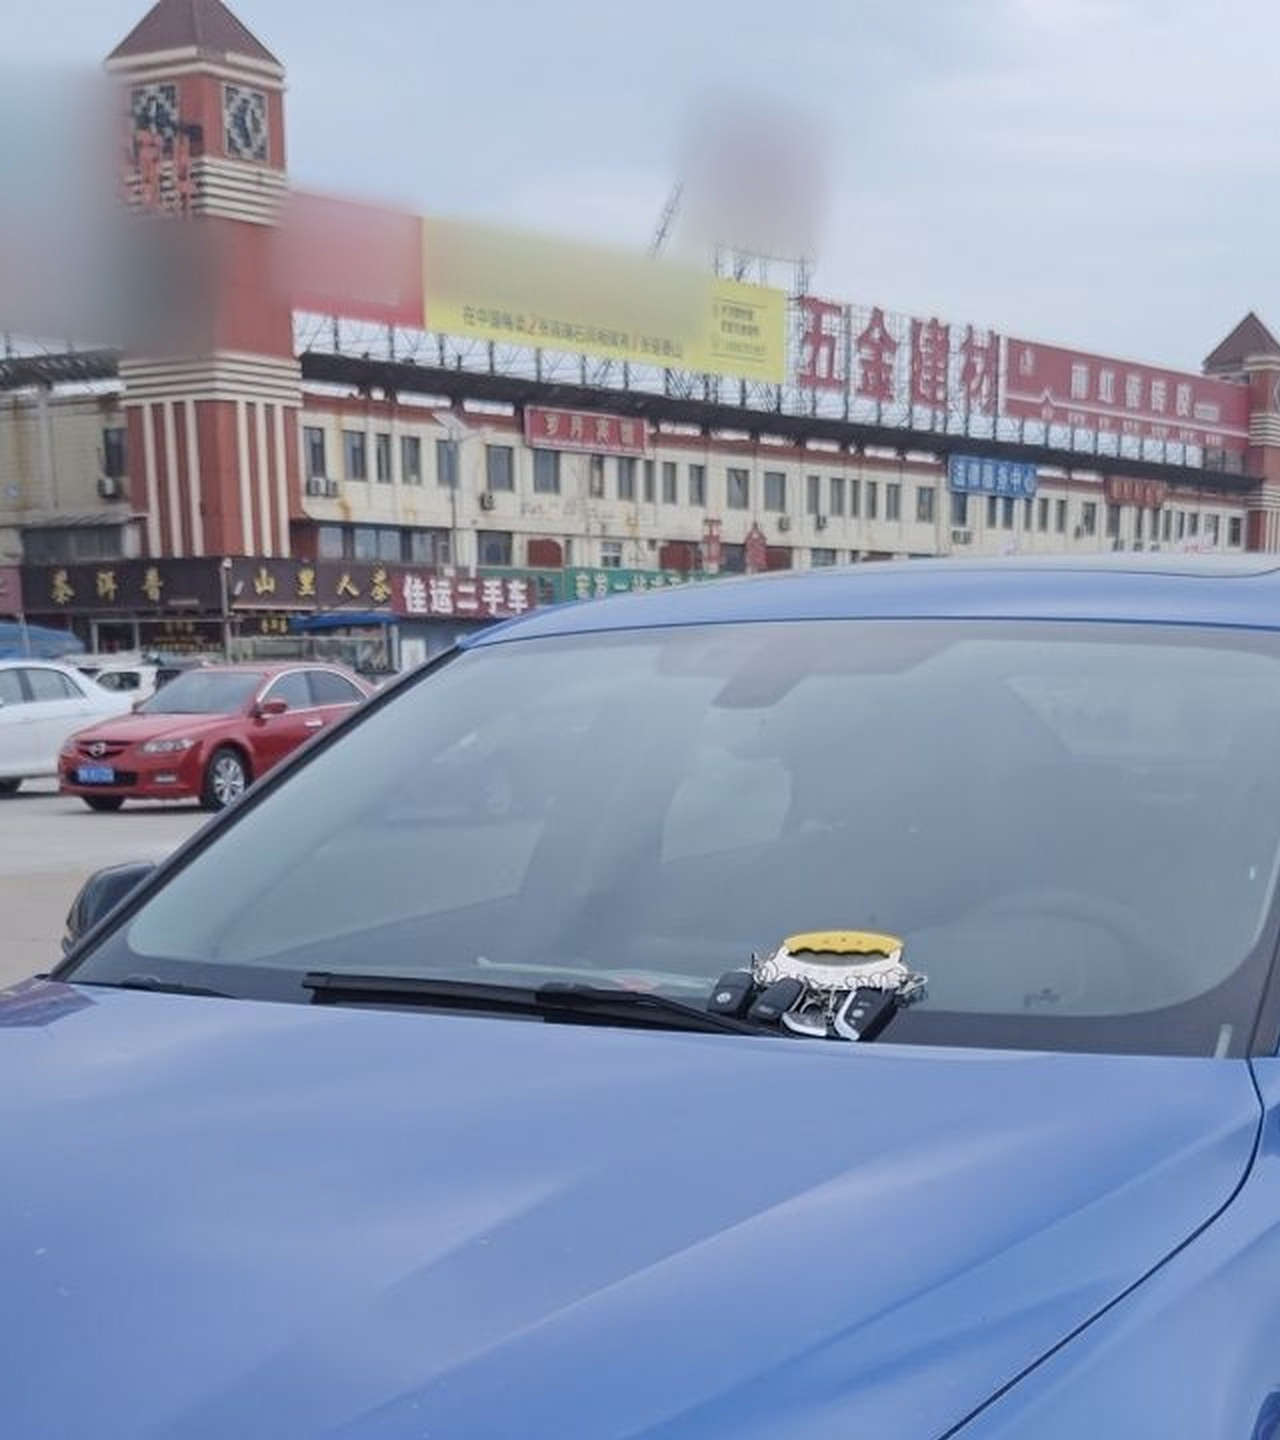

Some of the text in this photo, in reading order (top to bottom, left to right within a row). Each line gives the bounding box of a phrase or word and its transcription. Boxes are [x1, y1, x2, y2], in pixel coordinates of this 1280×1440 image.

[799, 294, 1000, 418] 五金建材
[403, 574, 529, 615] 佳运二手车
